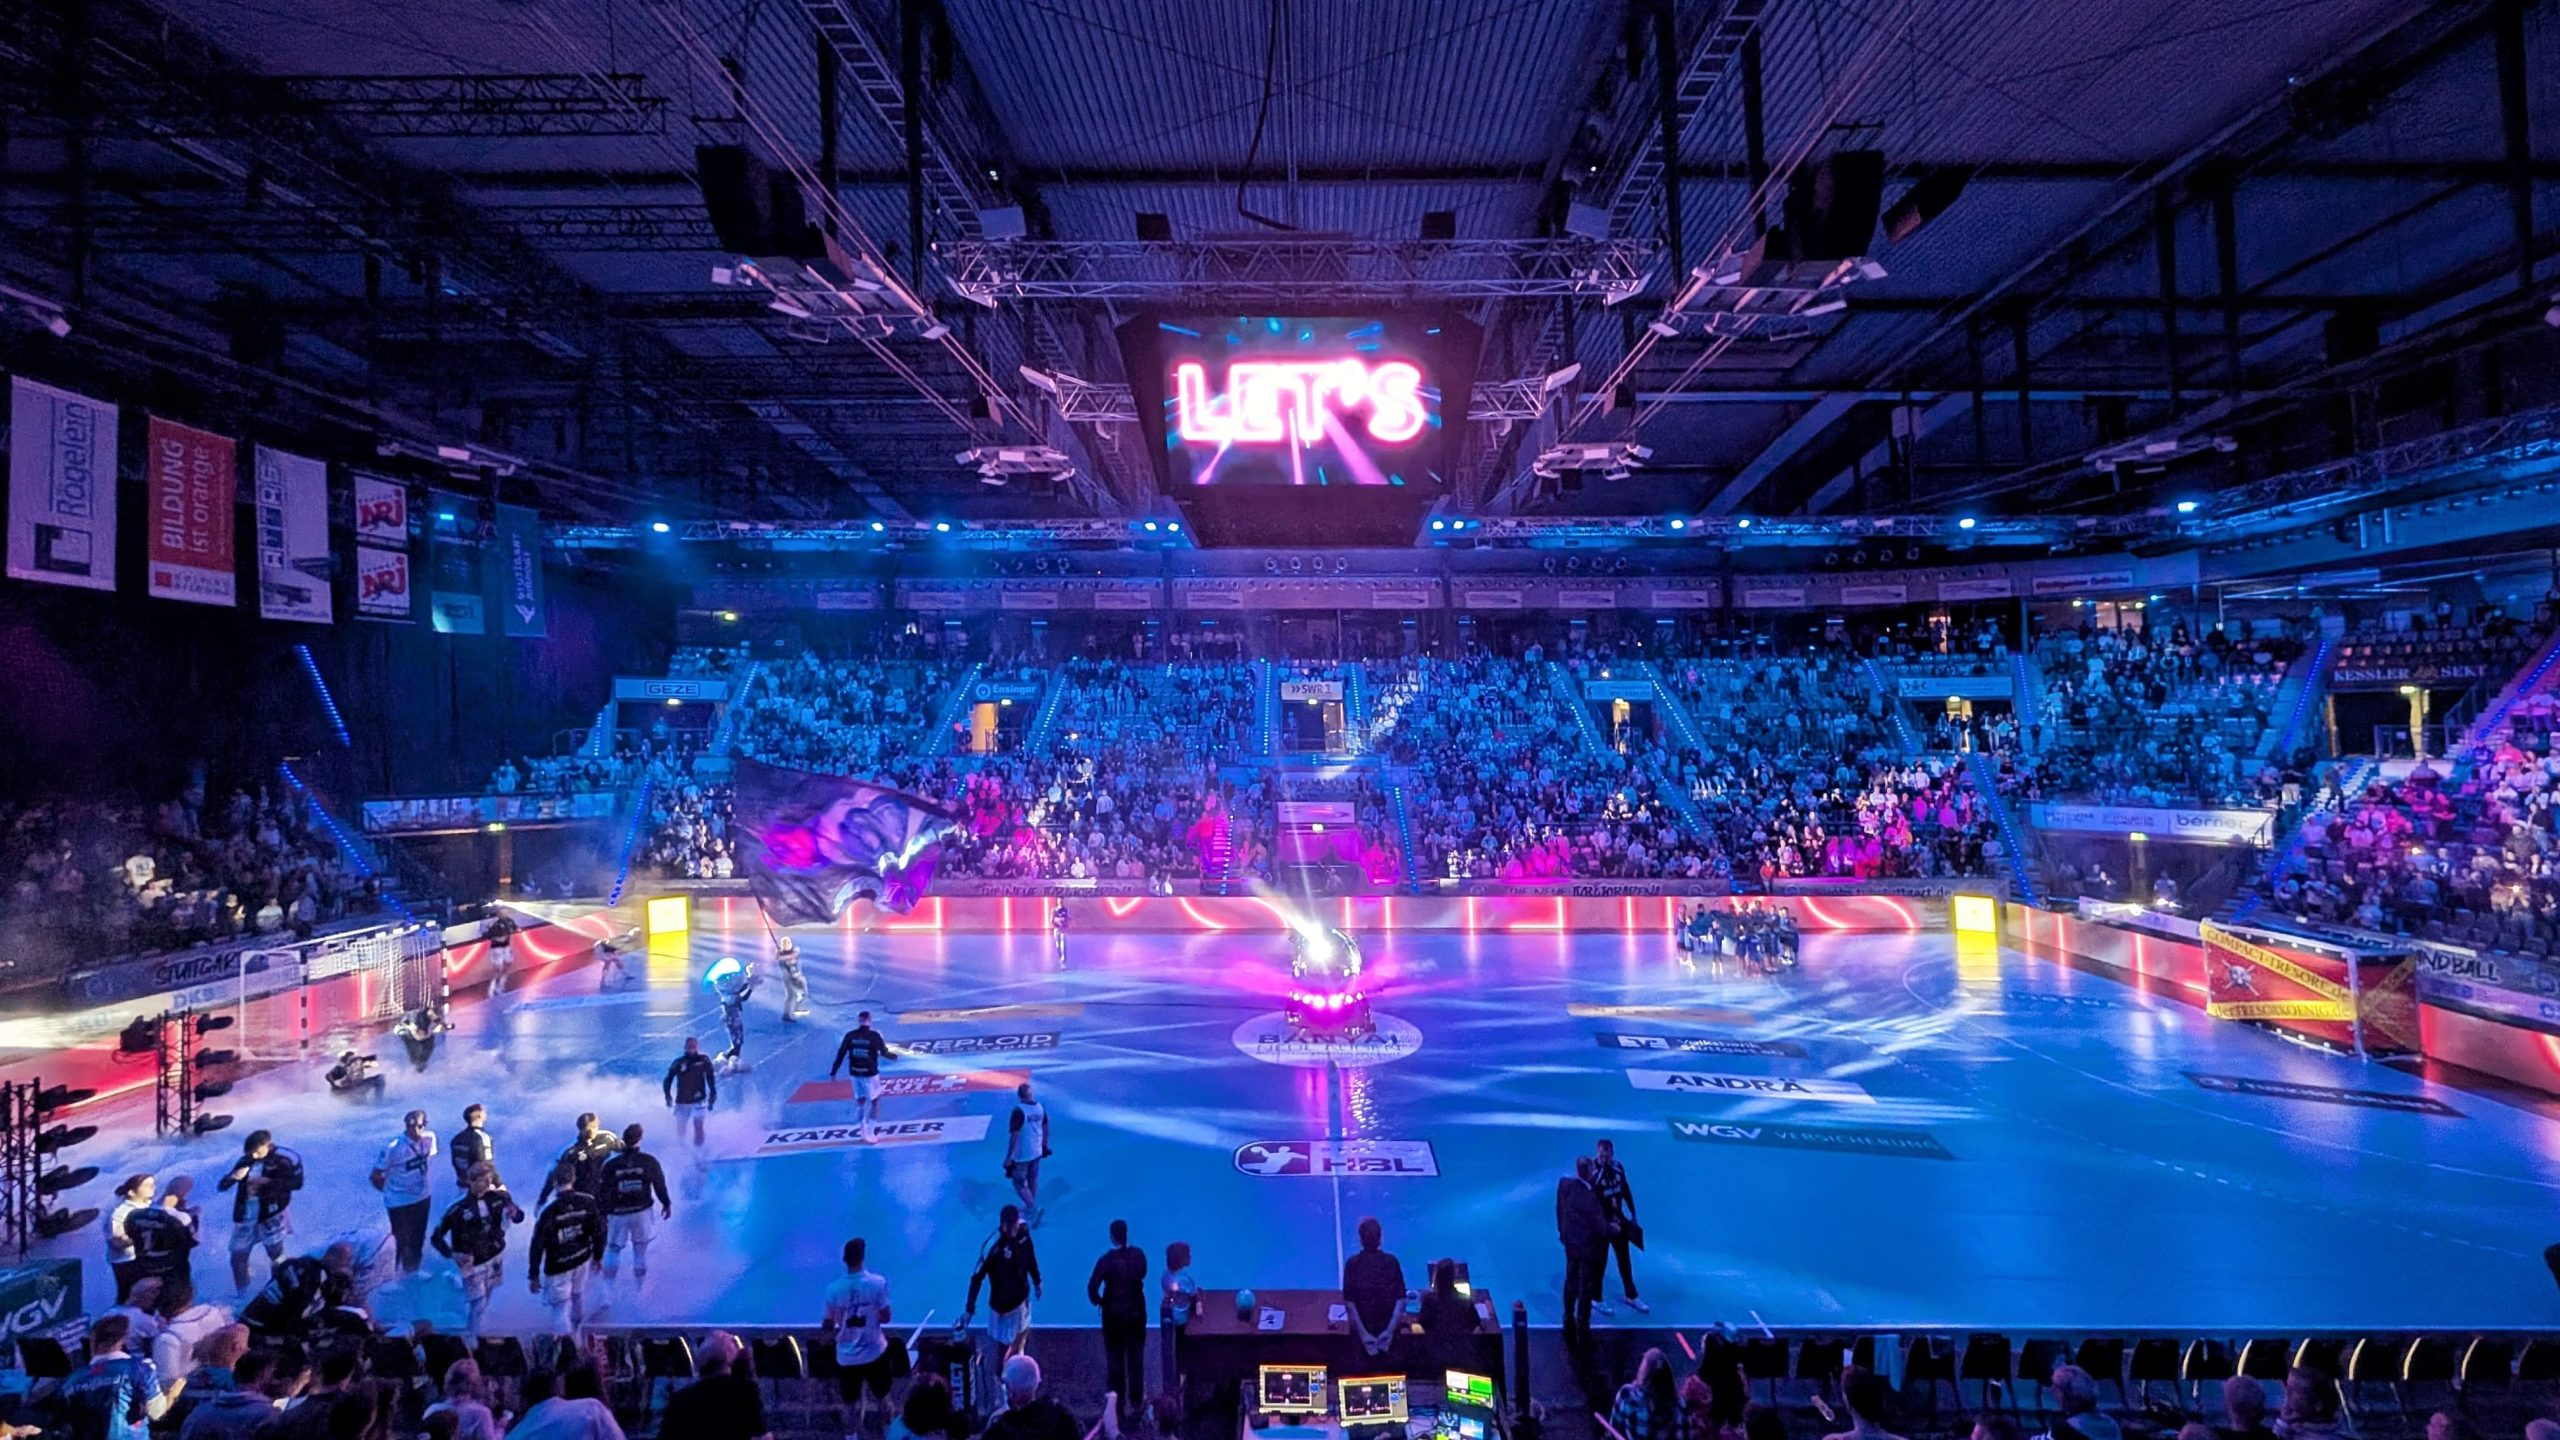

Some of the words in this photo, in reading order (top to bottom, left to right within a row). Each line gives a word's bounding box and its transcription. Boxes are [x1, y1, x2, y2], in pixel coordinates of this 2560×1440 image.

[1176, 358, 1427, 441] LET'S
[160, 437, 185, 550] BILDUNG
[191, 446, 215, 524] orange
[2334, 667, 2410, 682] KESSLER
[2441, 664, 2486, 678] SEKT
[649, 684, 696, 695] GEZE
[2176, 813, 2247, 830] berner
[154, 951, 242, 985] STUTTGAR
[2419, 949, 2499, 981] NDBALL
[909, 1034, 1053, 1050] REPLOID
[1666, 1074, 1813, 1094] ANDRÄ
[1674, 1122, 1762, 1140] WGV
[1322, 1157, 1424, 1172] HBL
